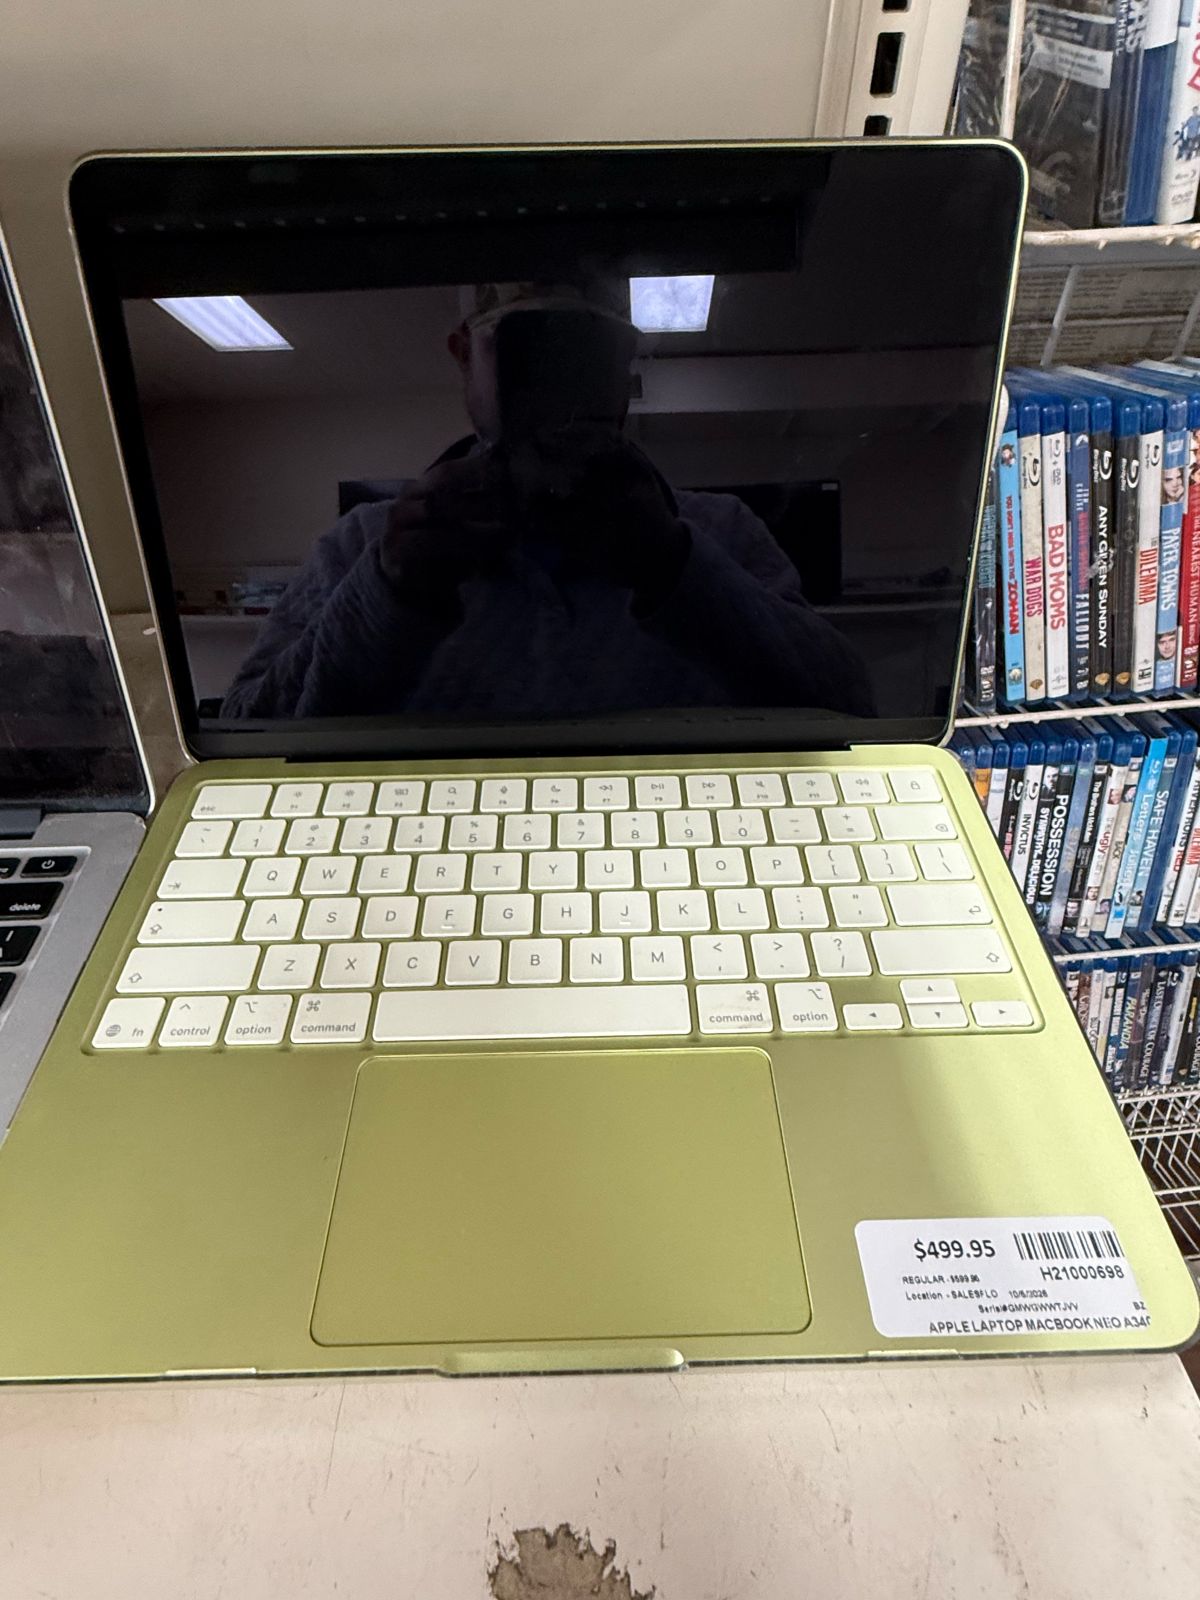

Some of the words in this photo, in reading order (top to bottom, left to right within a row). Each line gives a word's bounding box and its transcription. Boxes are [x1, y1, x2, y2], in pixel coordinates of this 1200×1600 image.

[1115, 18, 1126, 57] HELL
[1098, 505, 1108, 538] ANY
[1048, 524, 1065, 571] BAD
[1162, 528, 1181, 565] PAPER
[1191, 530, 1200, 578] NEAREST
[1025, 557, 1042, 584] WAR
[1138, 548, 1157, 605] DILEMMA
[1161, 567, 1179, 611] TOWNS
[1008, 580, 1020, 635] ZOHAN
[1026, 587, 1043, 618] DOGS
[1048, 573, 1066, 631] MOMS
[1188, 580, 1200, 623] HUMAN
[1075, 593, 1090, 650] FALLOUT
[1098, 589, 1108, 649] SUNDAY
[1149, 790, 1169, 826] SAFE
[468, 833, 478, 844] 5
[522, 832, 532, 842] 6
[577, 831, 585, 841] 7
[630, 829, 641, 840] 8
[684, 828, 694, 839] 9
[737, 827, 748, 838] 0
[1017, 813, 1032, 855] INVICTUS
[305, 836, 316, 847] 2
[359, 835, 370, 846] 3
[413, 834, 423, 844] 4
[1099, 831, 1111, 854] ugly
[1040, 795, 1069, 896] POSSESSION
[1138, 829, 1158, 877] HAVEN
[492, 865, 502, 876] T
[548, 864, 558, 875] Y
[603, 863, 615, 874] U
[715, 859, 727, 871] O
[772, 859, 782, 870] P
[266, 870, 279, 882] Q
[322, 868, 337, 880] W
[380, 867, 389, 879] E
[436, 866, 447, 878] R
[9, 902, 41, 911] delete
[560, 906, 572, 918] H
[620, 905, 629, 917] J
[678, 903, 689, 915] K
[737, 902, 747, 914] L
[266, 913, 278, 925] A
[326, 911, 338, 924] S
[385, 910, 397, 922] D
[444, 909, 454, 921] F
[502, 907, 514, 920] G
[406, 956, 419, 970] C
[468, 955, 480, 968] V
[530, 953, 541, 967] B
[590, 952, 602, 965] N
[651, 951, 665, 963] M
[283, 959, 296, 972] Z
[344, 957, 357, 971] X
[1155, 981, 1166, 1000] LAST
[709, 1012, 763, 1024] command
[793, 1011, 828, 1023] option
[132, 1027, 144, 1037] fn
[170, 1025, 210, 1037] control
[236, 1024, 271, 1036] option
[301, 1022, 356, 1033] command
[1139, 1041, 1155, 1078] COURAGE
[914, 1239, 995, 1262] $499.95
[1040, 1265, 1124, 1280] H21000698
[902, 1275, 945, 1284] REGULAR
[905, 1290, 943, 1301] Location
[951, 1290, 998, 1299] SALESFLO
[930, 1321, 970, 1333] APPLE
[972, 1320, 1023, 1332] LAPTOP
[1025, 1317, 1093, 1331] MACBOOK
[1093, 1316, 1121, 1329] NEO
